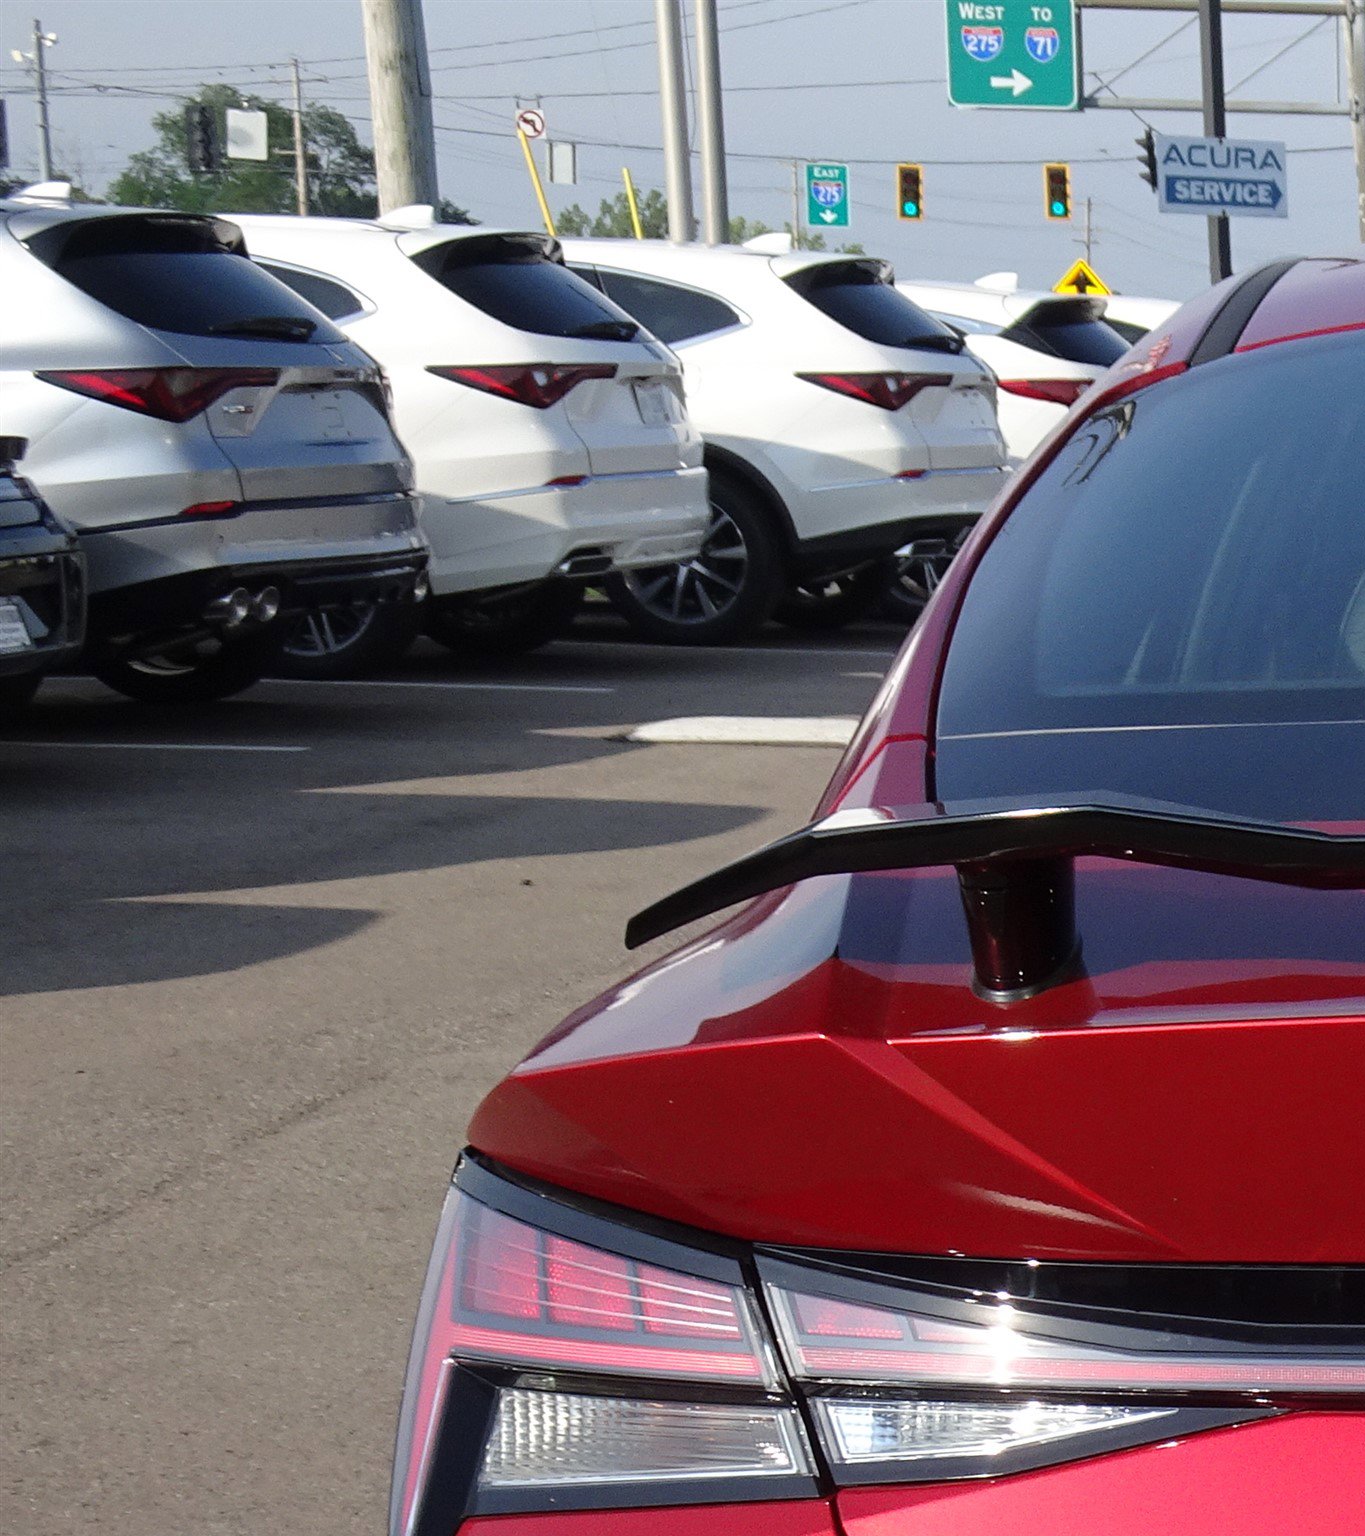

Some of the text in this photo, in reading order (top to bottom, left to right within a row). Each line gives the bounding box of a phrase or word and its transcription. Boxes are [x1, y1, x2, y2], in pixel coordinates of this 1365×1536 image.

[958, 2, 1052, 21] WEST TO
[967, 34, 1052, 56] 275 71
[1163, 143, 1282, 172] ACURA
[818, 186, 840, 203] 275
[1174, 179, 1273, 205] SERVICE
